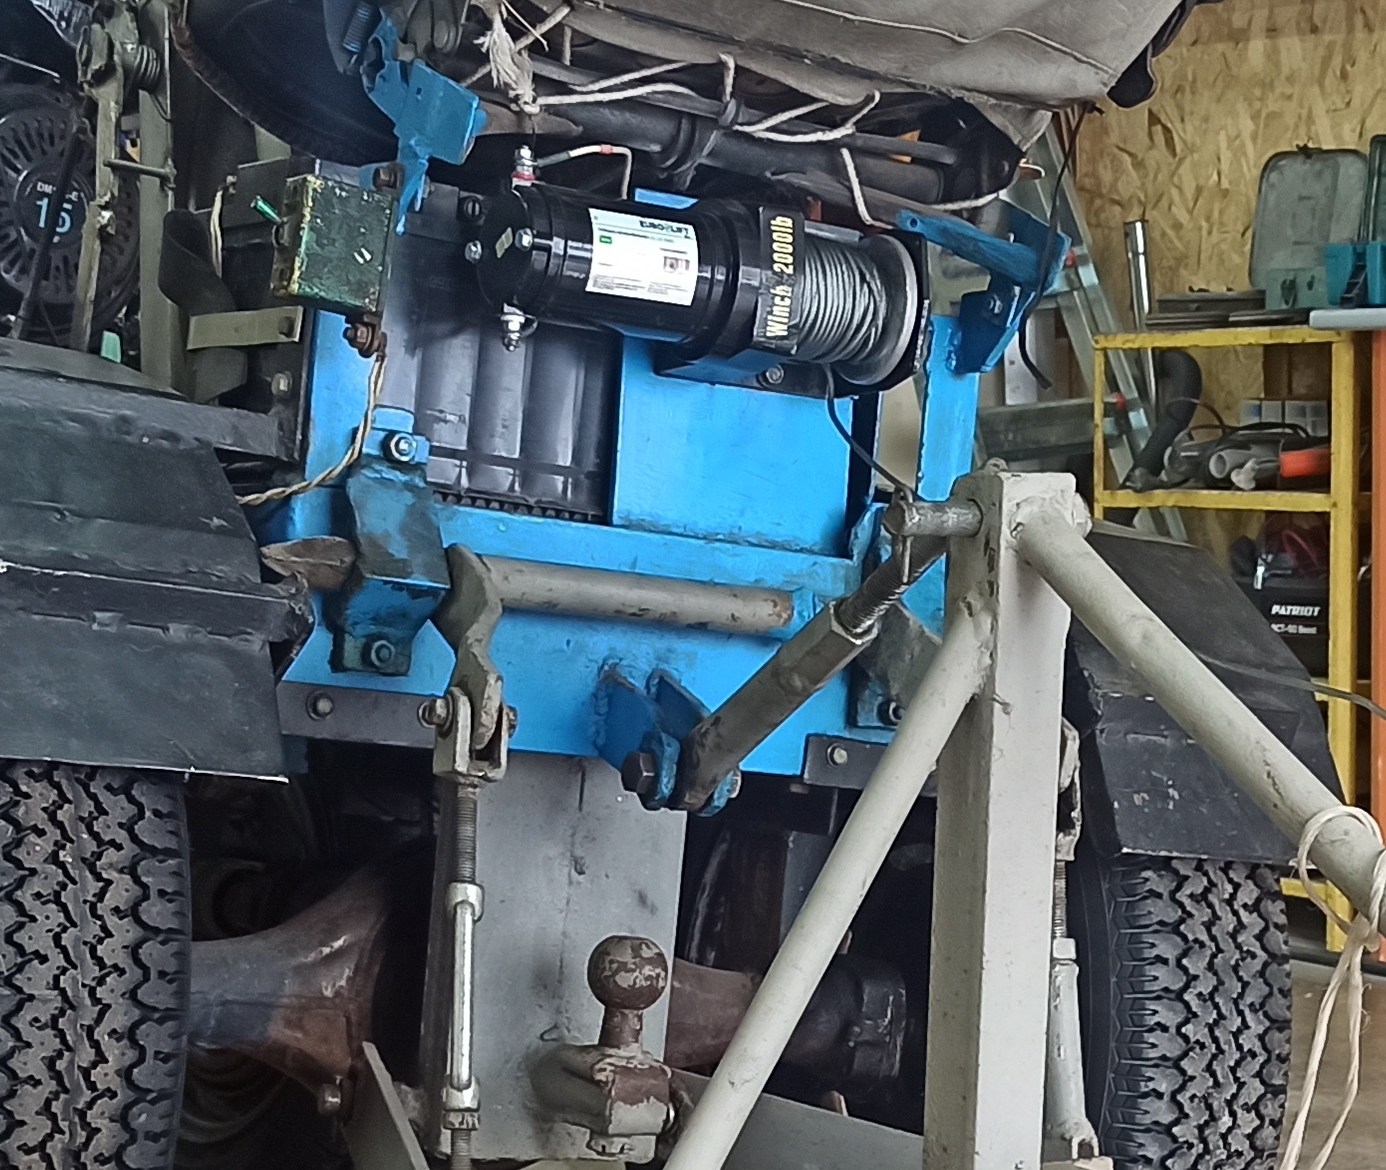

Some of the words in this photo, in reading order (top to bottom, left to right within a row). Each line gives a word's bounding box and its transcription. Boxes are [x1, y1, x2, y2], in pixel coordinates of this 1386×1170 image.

[770, 215, 794, 275] 2000lb
[766, 284, 793, 337] Winch
[1271, 604, 1321, 617] PATRIOT
